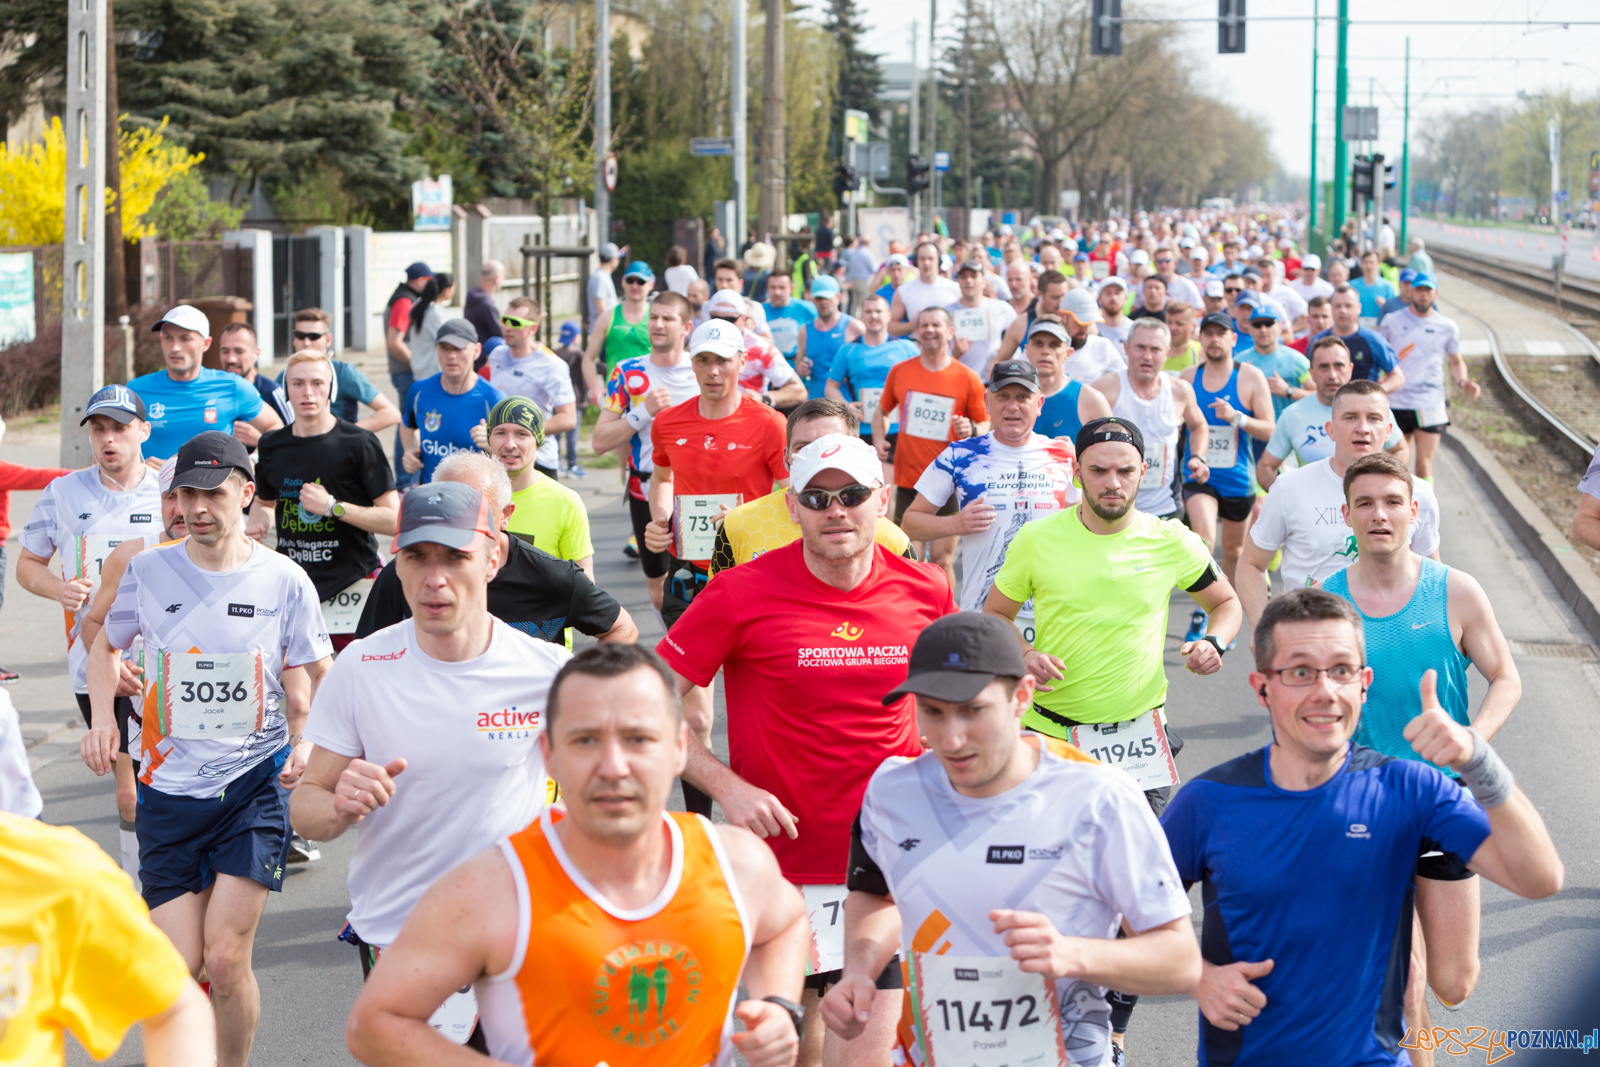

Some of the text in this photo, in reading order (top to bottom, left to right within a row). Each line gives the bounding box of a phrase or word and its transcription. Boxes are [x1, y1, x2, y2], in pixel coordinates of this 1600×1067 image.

[914, 407, 946, 422] 8023
[1018, 472, 1045, 481] Bieg
[988, 481, 1054, 490] Europejski
[297, 540, 339, 550] Biegacza
[798, 645, 909, 659] SPORTOWA PACZKA
[798, 656, 909, 667] POCZTOWA GRUPA BIEGOWA
[181, 681, 247, 703] 3036
[477, 706, 540, 727] active
[488, 731, 529, 740] NEKLA
[1090, 737, 1157, 764] 11945
[937, 995, 1040, 1031] 11472
[608, 1017, 681, 1047] KALISZ
